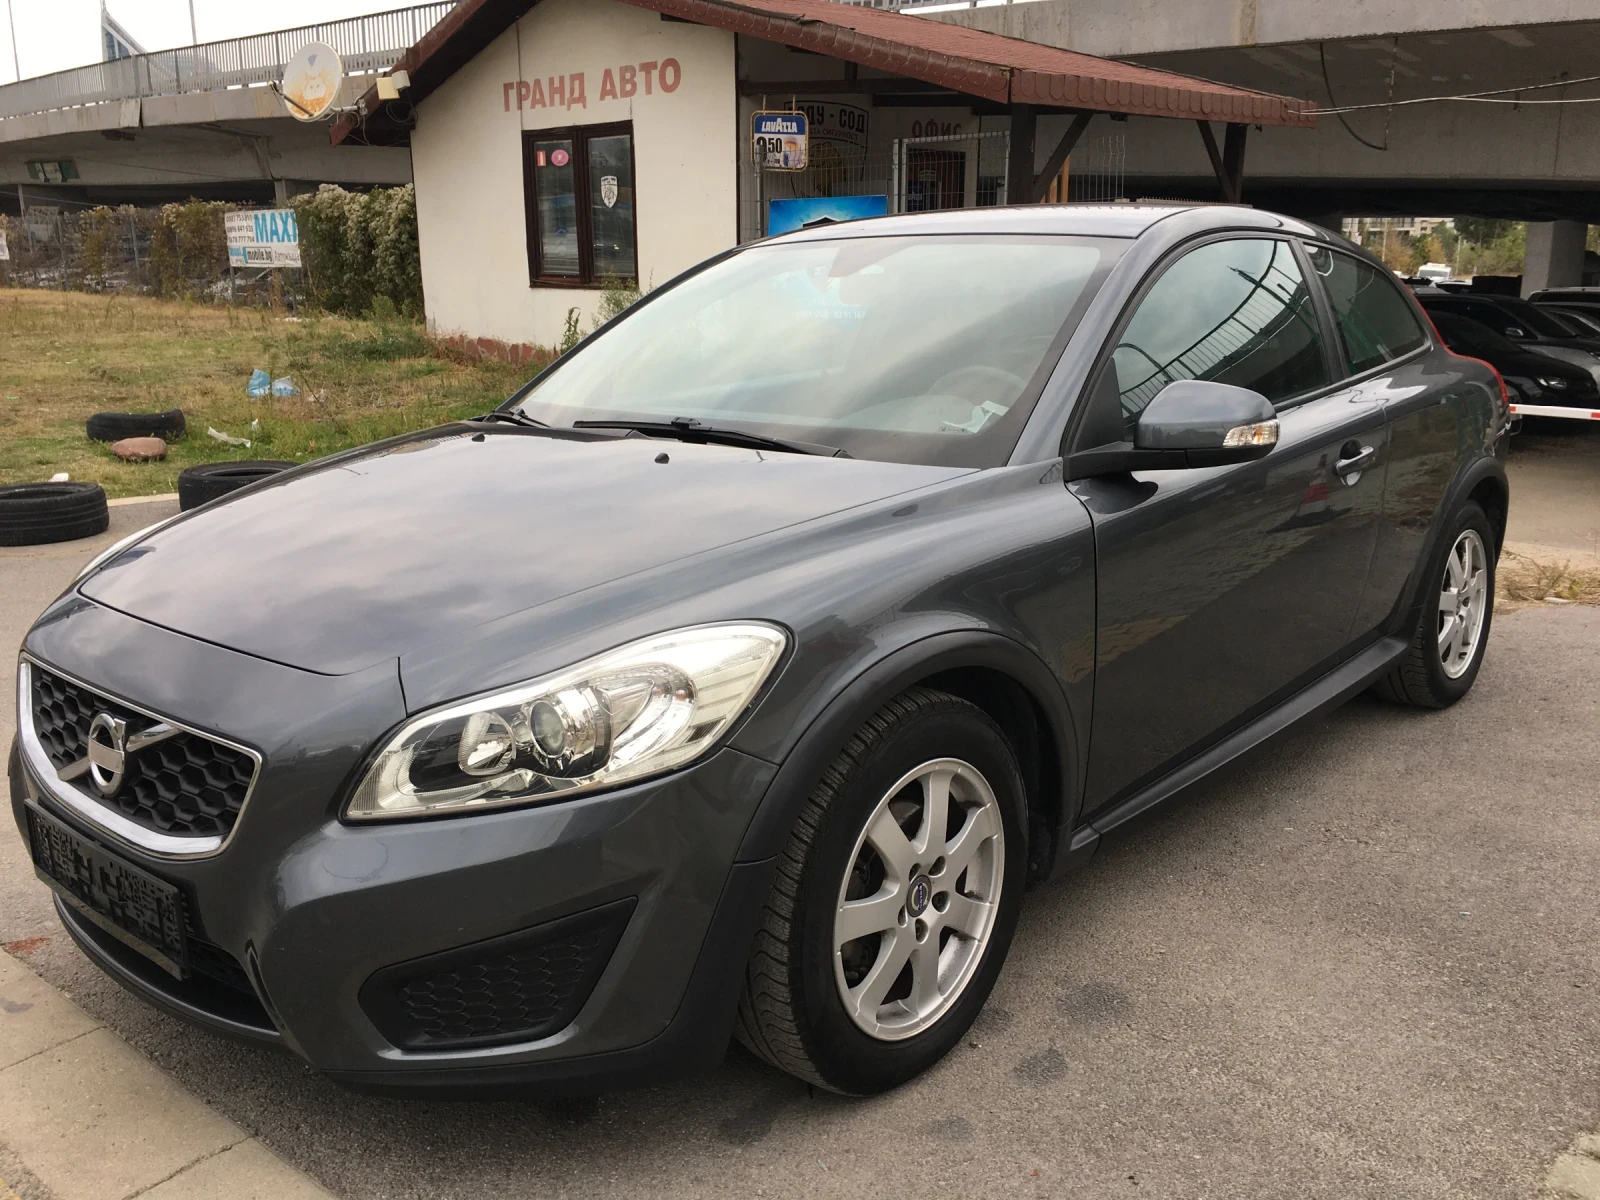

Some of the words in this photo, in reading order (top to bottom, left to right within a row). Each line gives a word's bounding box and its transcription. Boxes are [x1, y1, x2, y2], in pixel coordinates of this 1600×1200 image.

[503, 72, 587, 112] ГРАНД
[599, 57, 682, 102] АВТО
[761, 117, 798, 133] LAVAZZA
[840, 108, 865, 134] СОД
[912, 119, 962, 142] ОФИС
